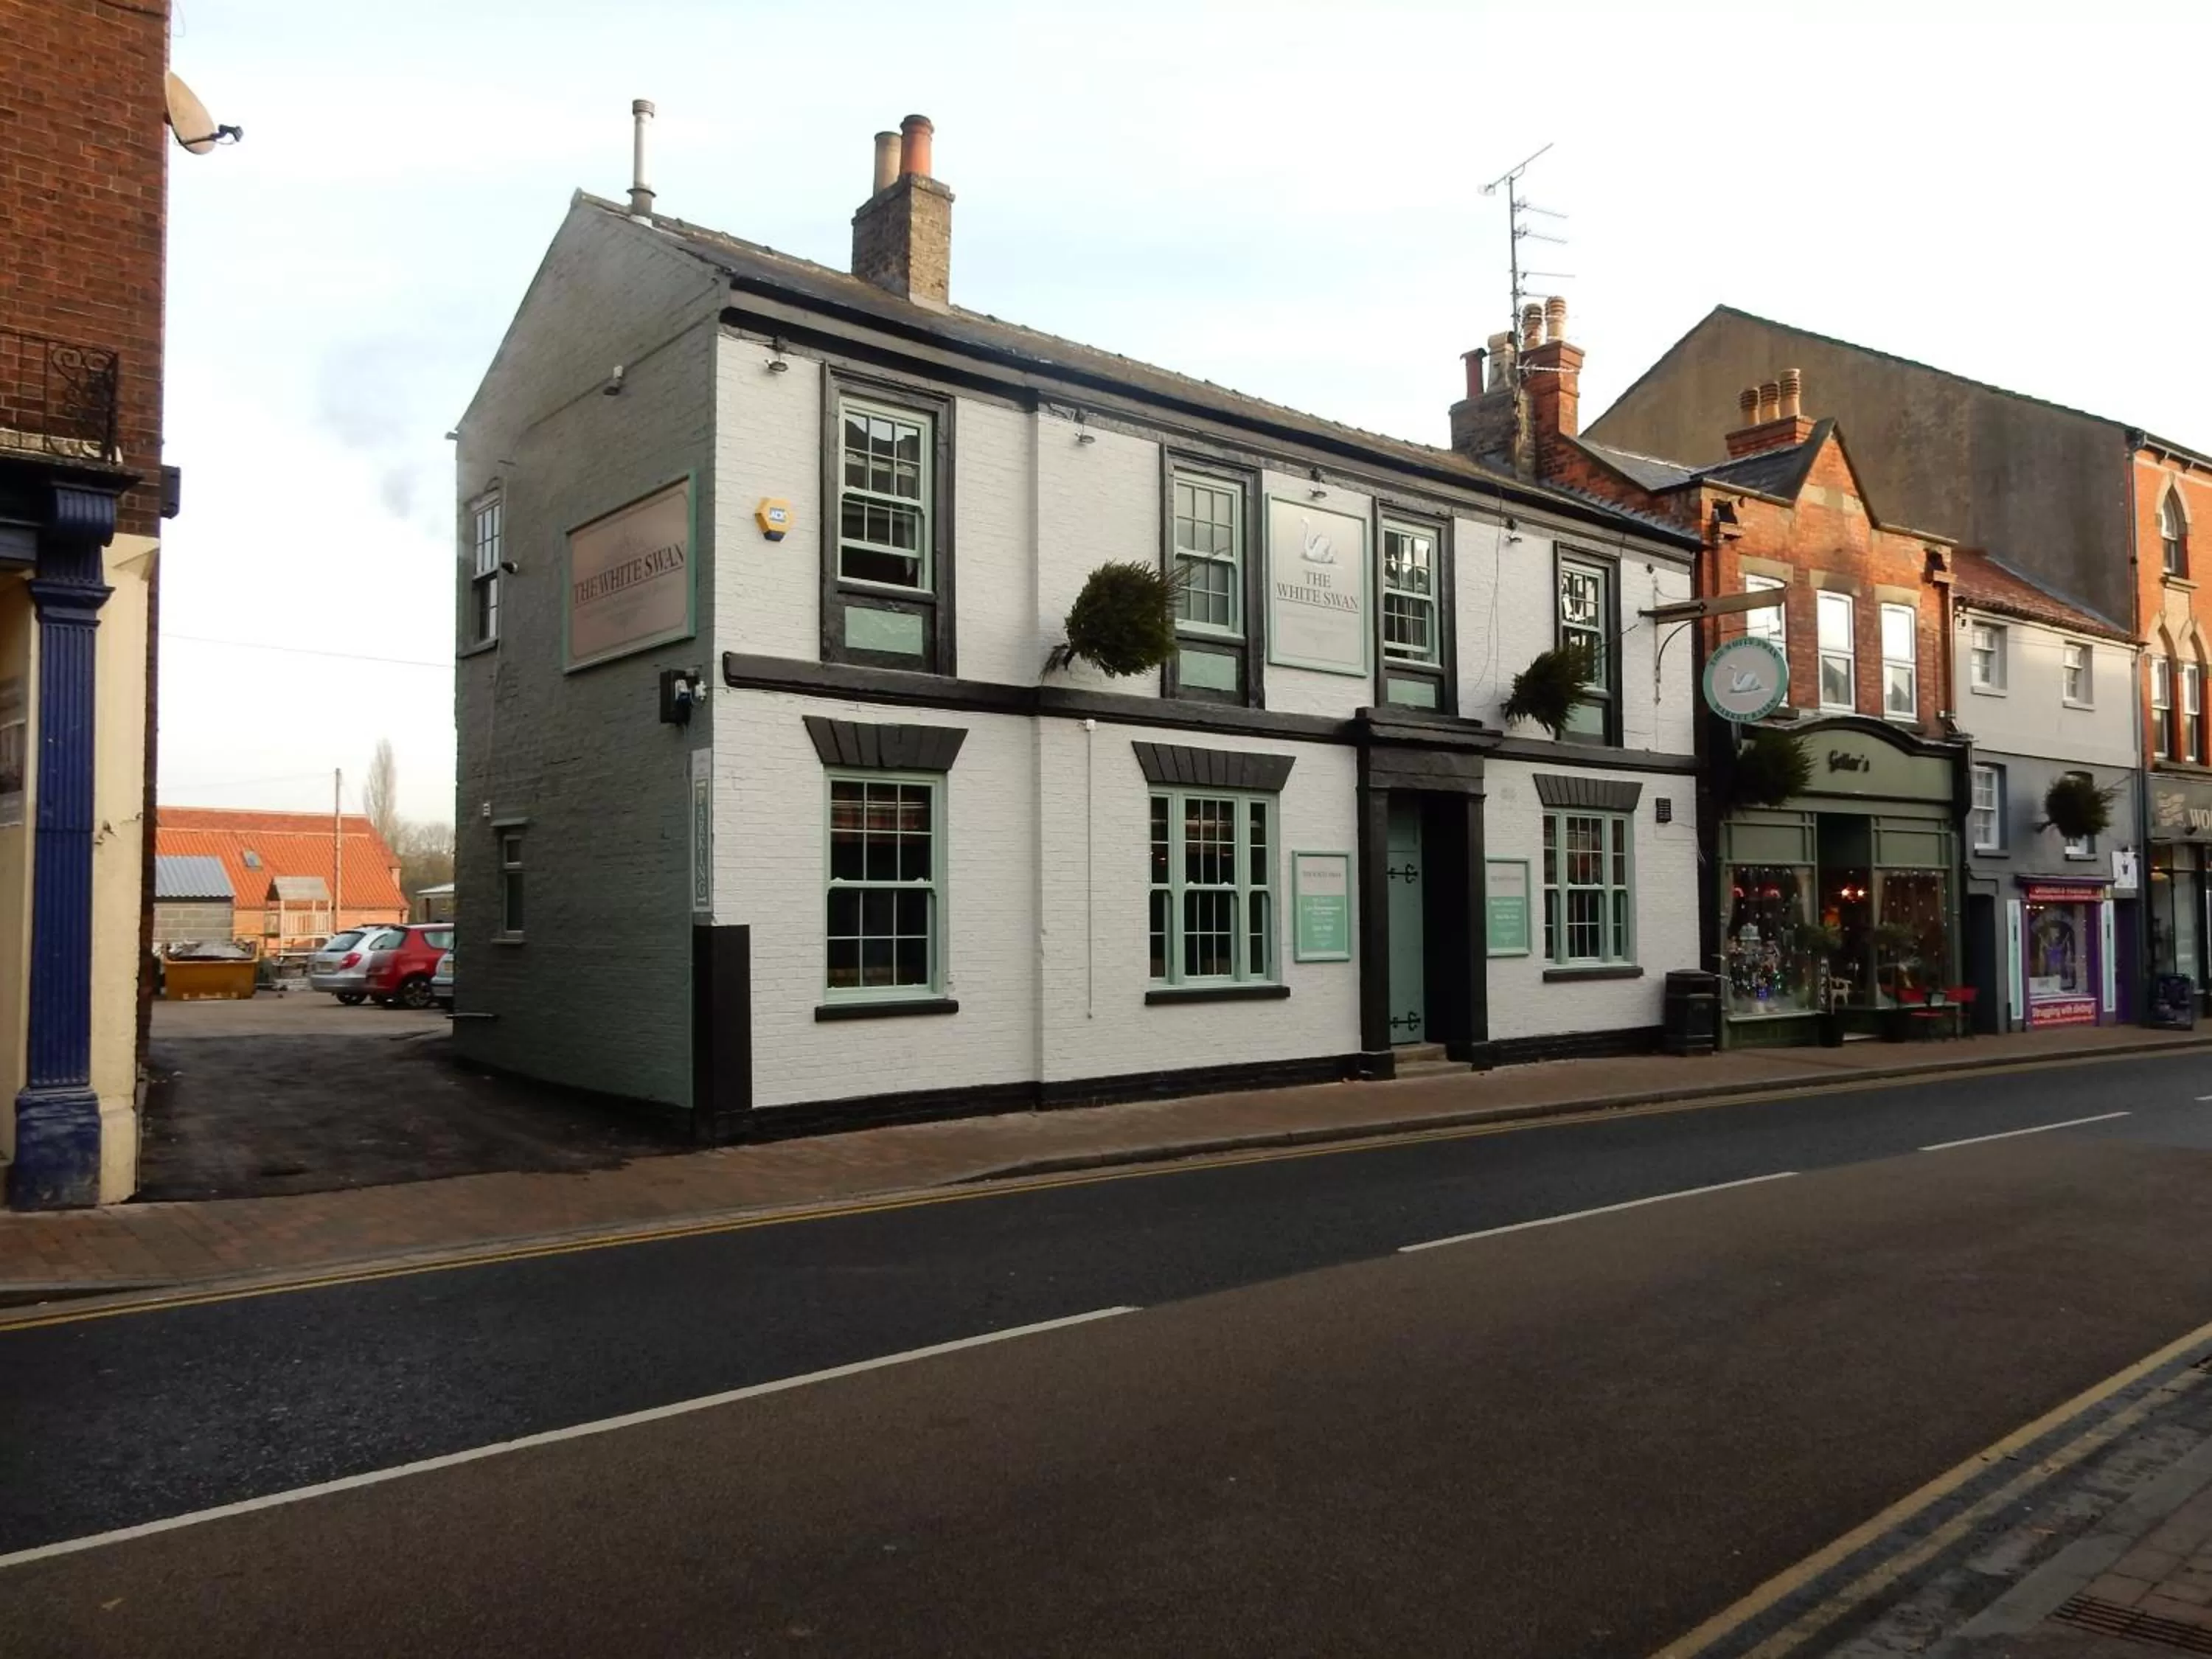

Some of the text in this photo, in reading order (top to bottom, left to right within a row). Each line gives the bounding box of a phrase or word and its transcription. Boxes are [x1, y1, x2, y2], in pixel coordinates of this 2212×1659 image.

[574, 541, 685, 604] THE WHITE SWAN
[1304, 571, 1332, 588] THE
[1276, 582, 1359, 610] WHITE SWAN
[1725, 639, 1755, 650] WHITE
[1756, 639, 1779, 658] SWAN
[1715, 700, 1747, 720] MARKET
[2189, 808, 2212, 830] WO
